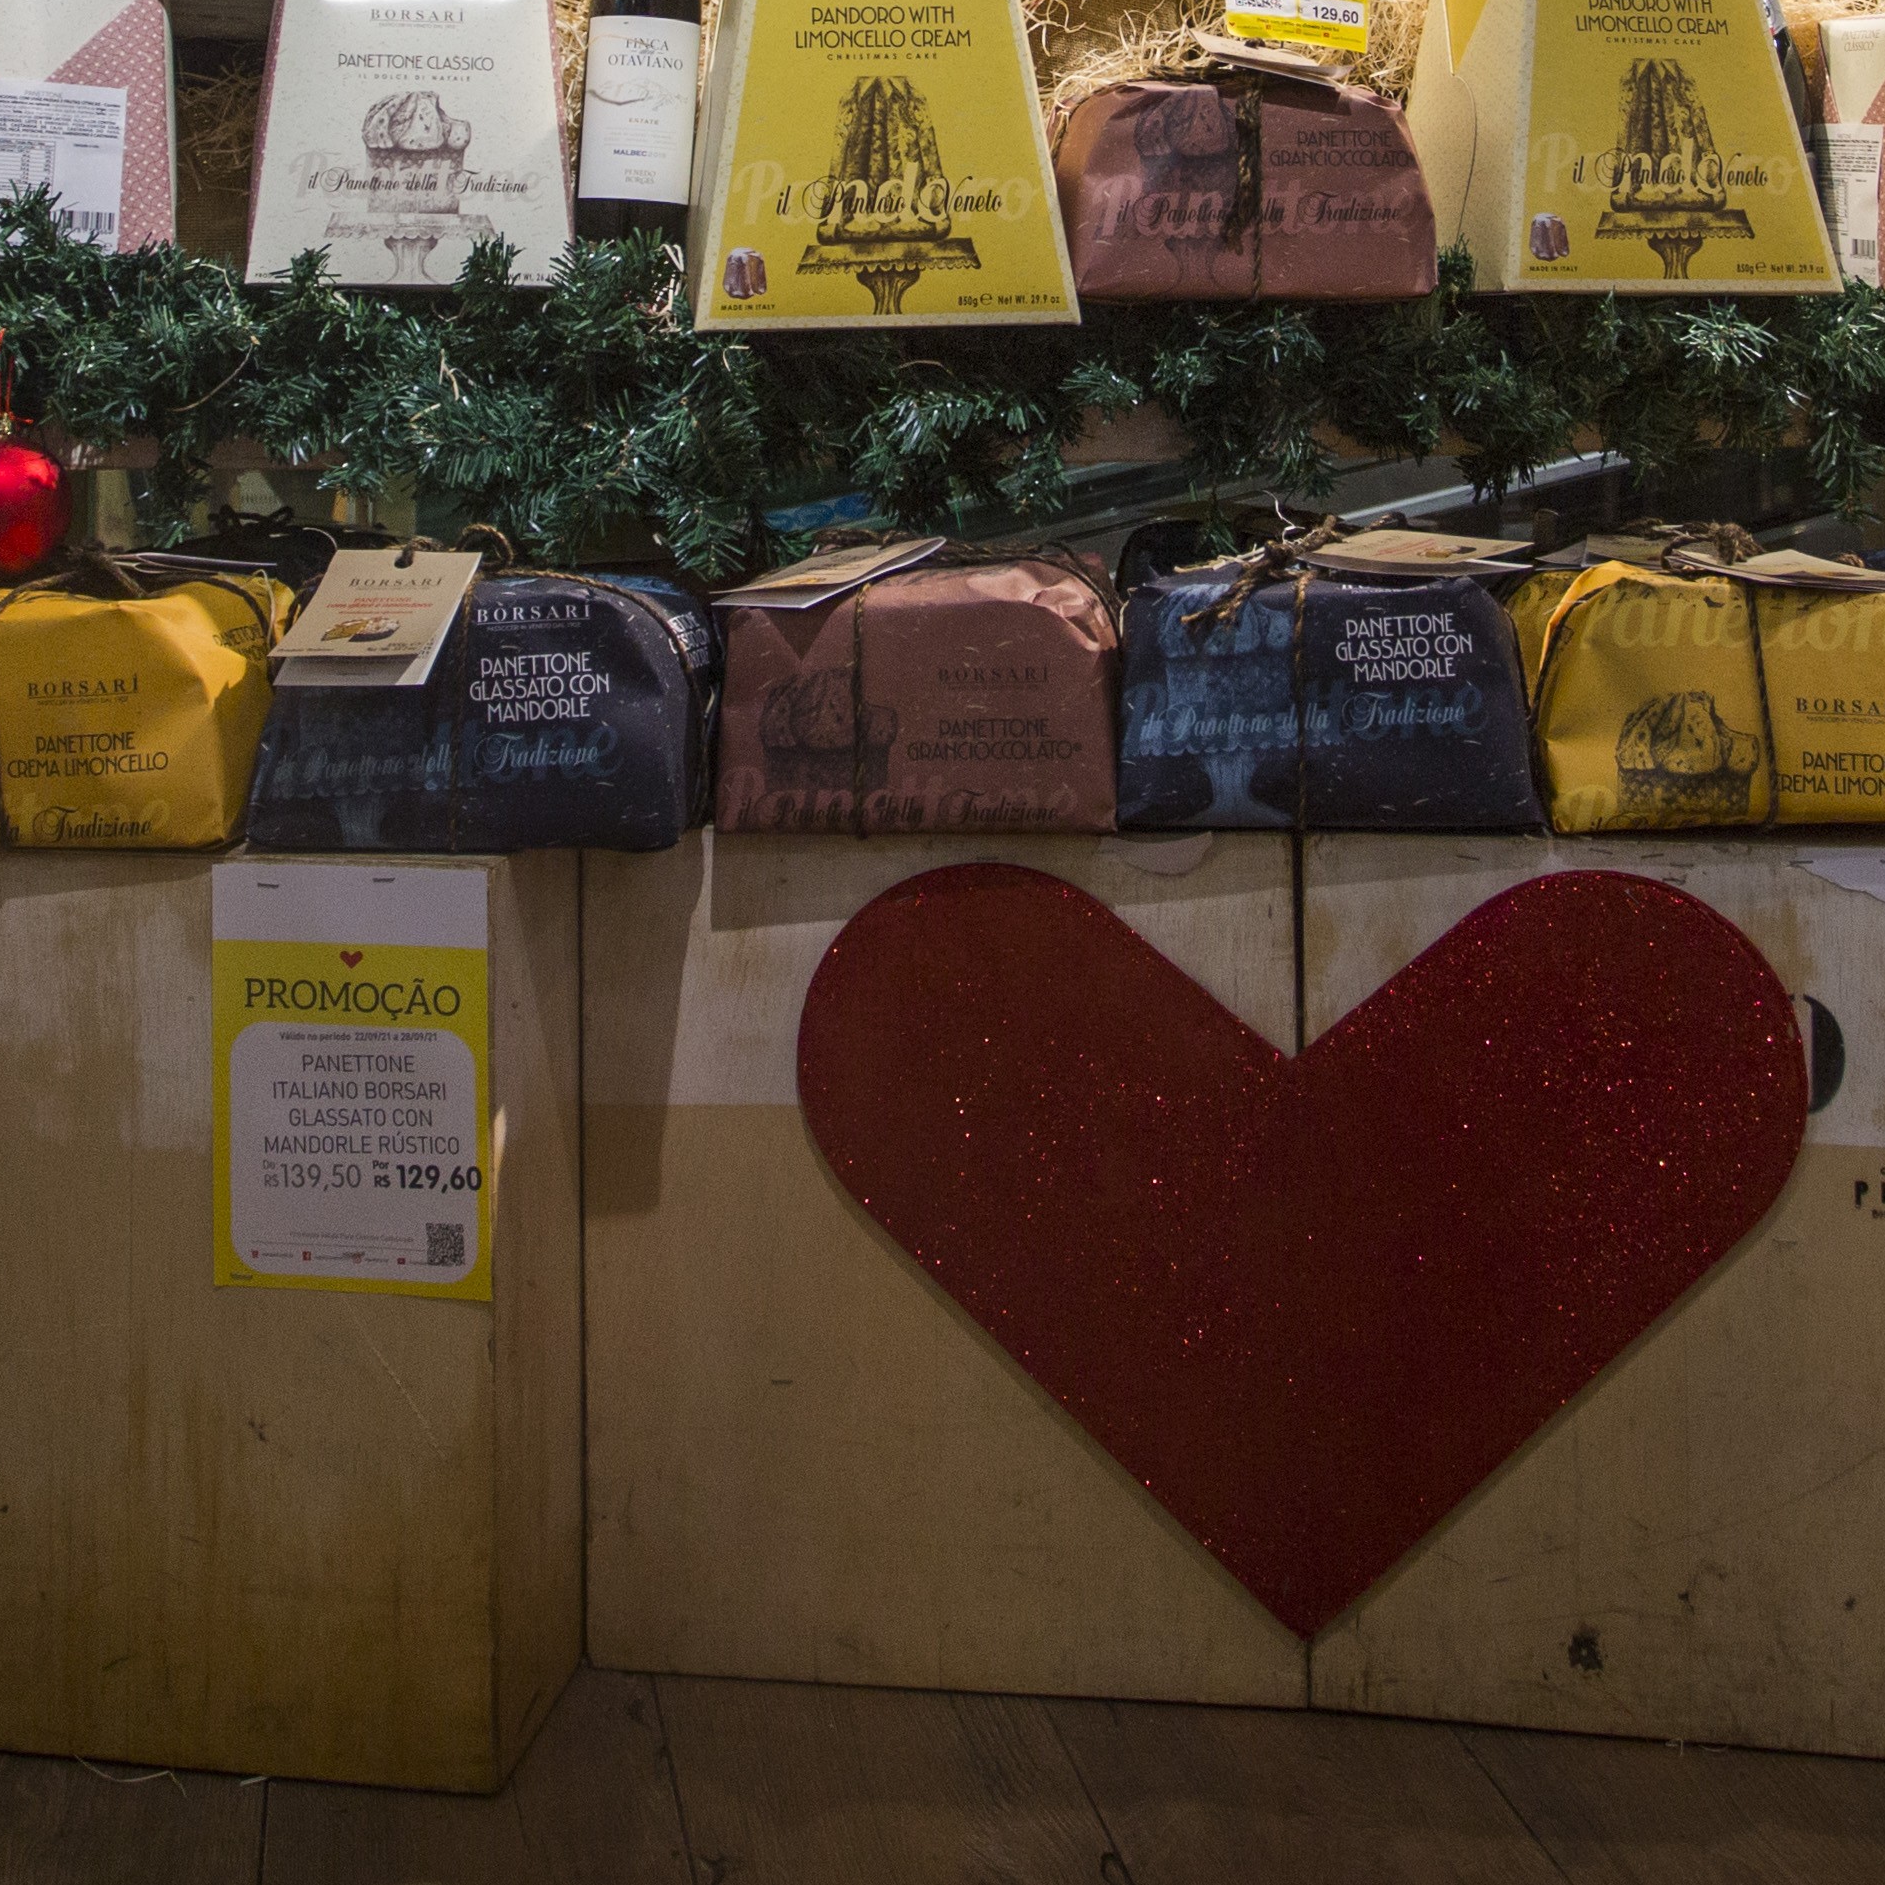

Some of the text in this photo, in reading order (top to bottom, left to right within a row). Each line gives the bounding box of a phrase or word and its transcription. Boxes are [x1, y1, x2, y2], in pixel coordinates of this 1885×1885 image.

[811, 5, 954, 25] PANDORO WITH
[1313, 6, 1359, 24] 129,60
[1576, 15, 1728, 35] LIMONCELLO CREAM
[626, 38, 669, 51] FINCA
[795, 29, 971, 49] LIMONCELLO CREAM
[1674, 38, 1702, 46] CAKE
[338, 53, 494, 71] PANETTONE CLASSICO
[608, 54, 683, 70] OTAVIANO
[827, 53, 898, 61] CHRISTMAS
[613, 149, 647, 157] MALBEC
[625, 176, 654, 184] BORGES
[1737, 263, 1784, 275] 850g Net
[957, 294, 1049, 307] 850g Net 29.9
[1345, 613, 1455, 638] PANETTONE
[1335, 635, 1473, 661] GLASSATO CON
[481, 652, 592, 678] PANETTONE
[1355, 658, 1455, 682] MANDORLE
[470, 673, 609, 701] GLASSATO CON
[488, 697, 590, 723] MANDORLE
[35, 731, 135, 754] PANETTONE
[6, 751, 168, 778] CREMA LIMONCELLO
[244, 977, 461, 1020] PROMOÇÃO
[279, 1031, 391, 1042] Válido 22/09/21
[302, 1054, 415, 1073] PANETTONE
[272, 1081, 447, 1101] ITALIANO BORSARI
[288, 1108, 433, 1128] GLASSATO CON
[264, 1132, 459, 1155] MANDORLE RÚSTICO
[279, 1163, 482, 1193] 139,50 129,60
